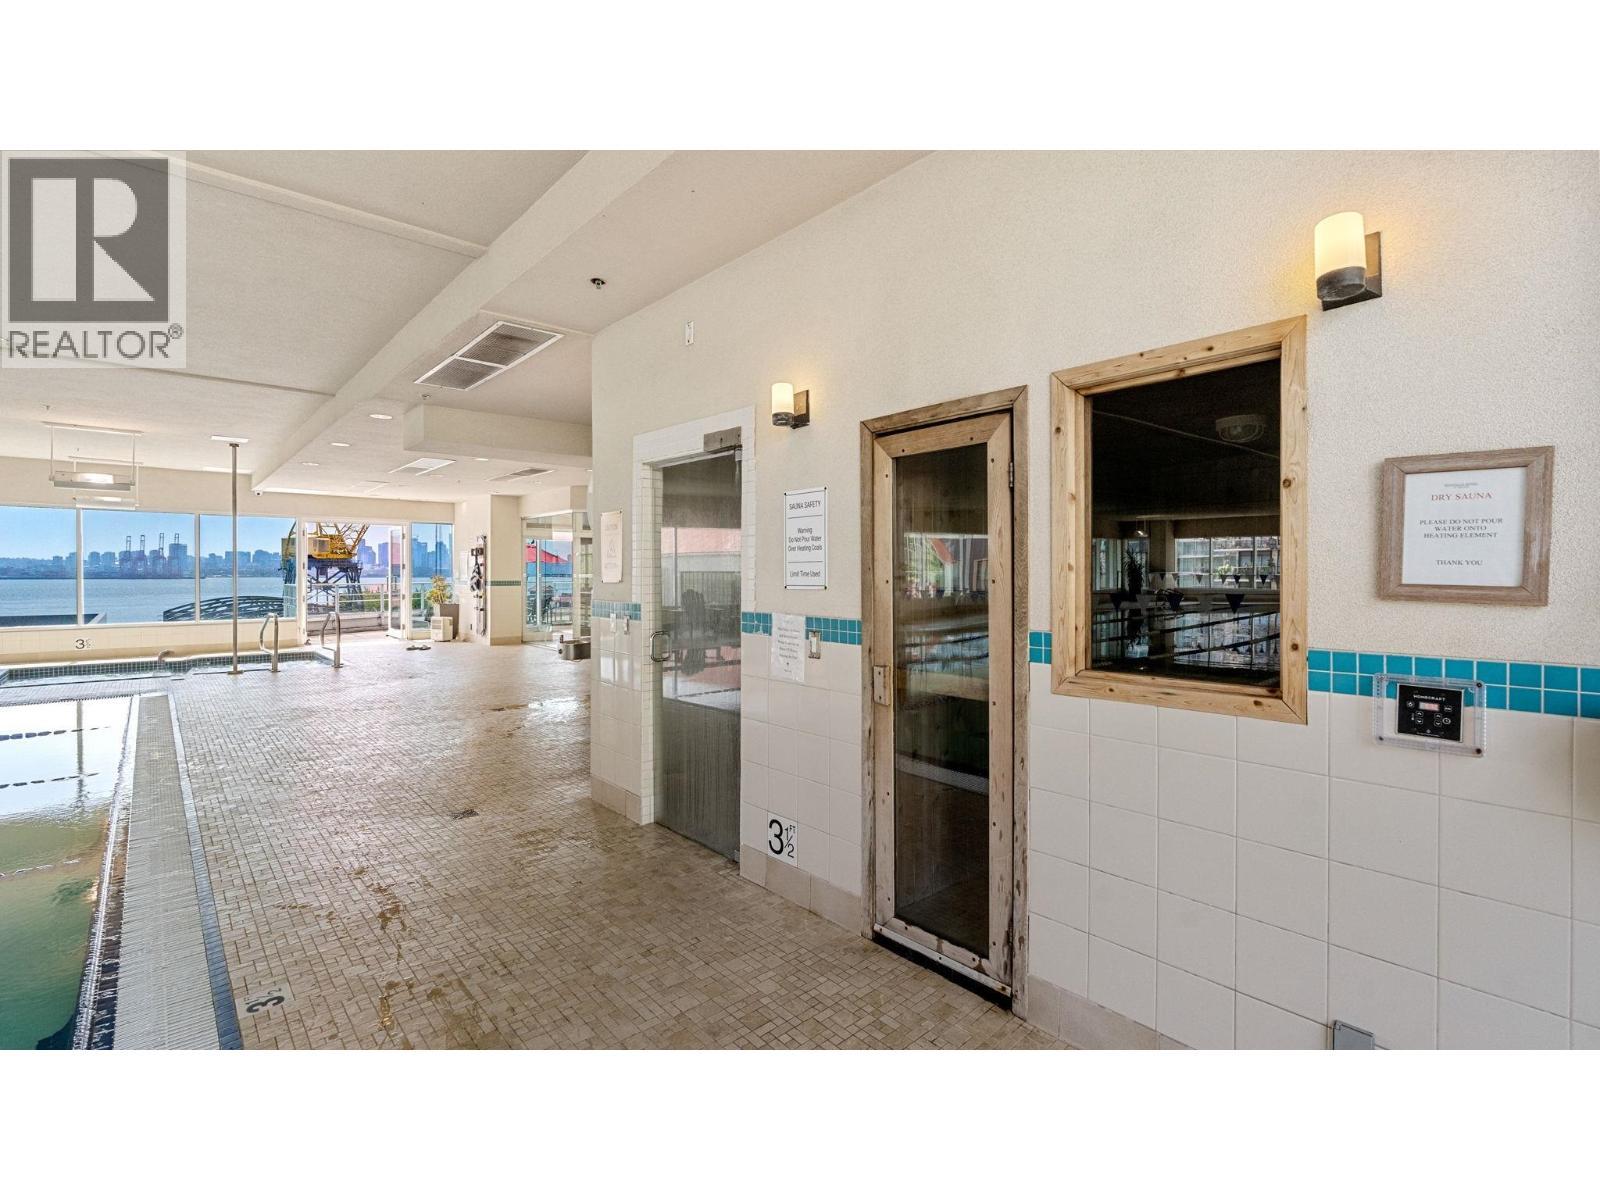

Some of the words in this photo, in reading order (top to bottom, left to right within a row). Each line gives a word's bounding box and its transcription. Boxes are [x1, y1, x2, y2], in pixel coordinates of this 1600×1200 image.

[1431, 493, 1452, 501] DRY
[1455, 491, 1493, 501] SAUNA
[804, 500, 821, 509] SAFETY
[797, 527, 813, 535] Warning
[797, 545, 812, 553] Heating
[75, 638, 85, 650] 3
[769, 819, 784, 855] 3
